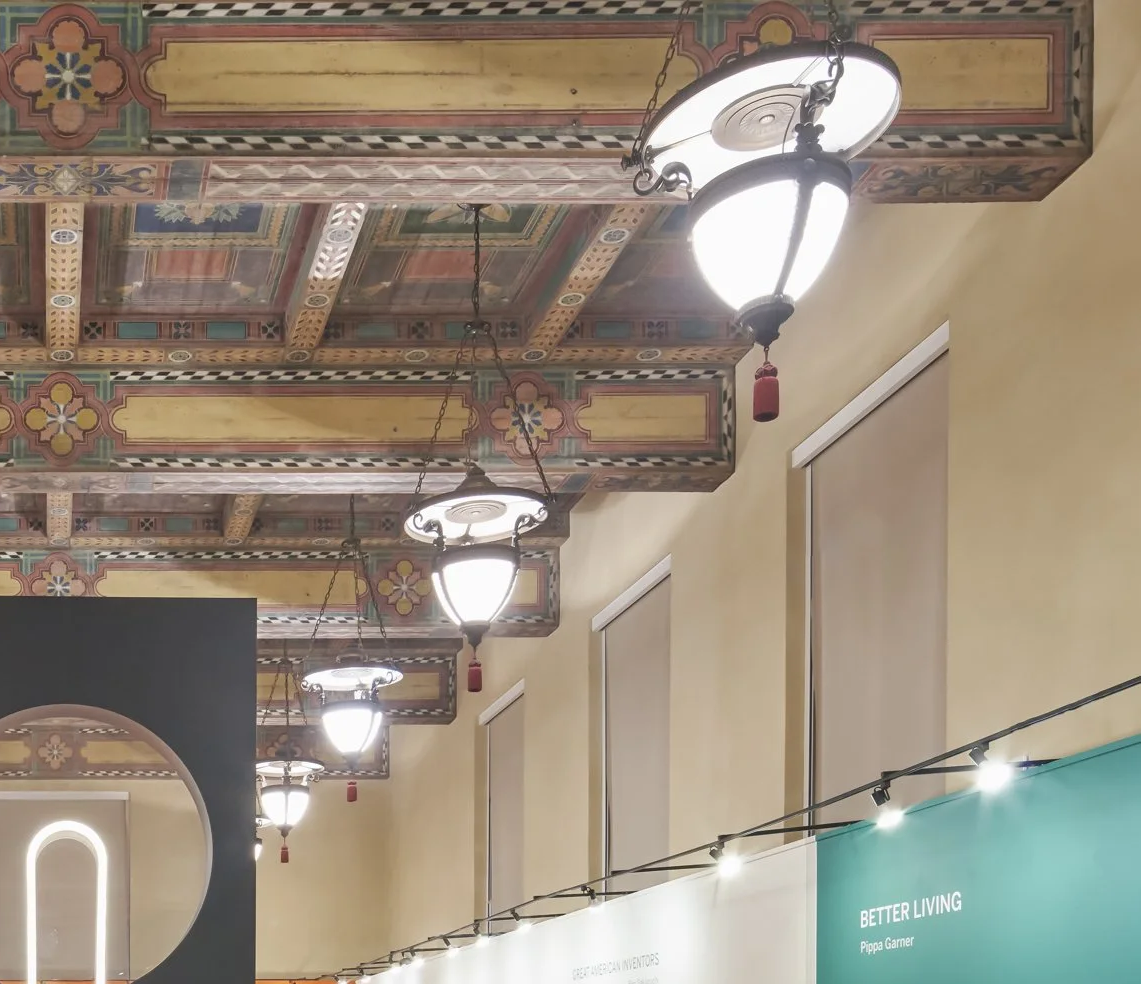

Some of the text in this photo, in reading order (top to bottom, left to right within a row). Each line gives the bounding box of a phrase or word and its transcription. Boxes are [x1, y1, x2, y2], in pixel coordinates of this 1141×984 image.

[860, 891, 962, 929] BETTER LIVING
[860, 937, 915, 955] Pippa Garner
[591, 961, 620, 976] AMERICAN
[622, 952, 660, 971] INVENTORS
